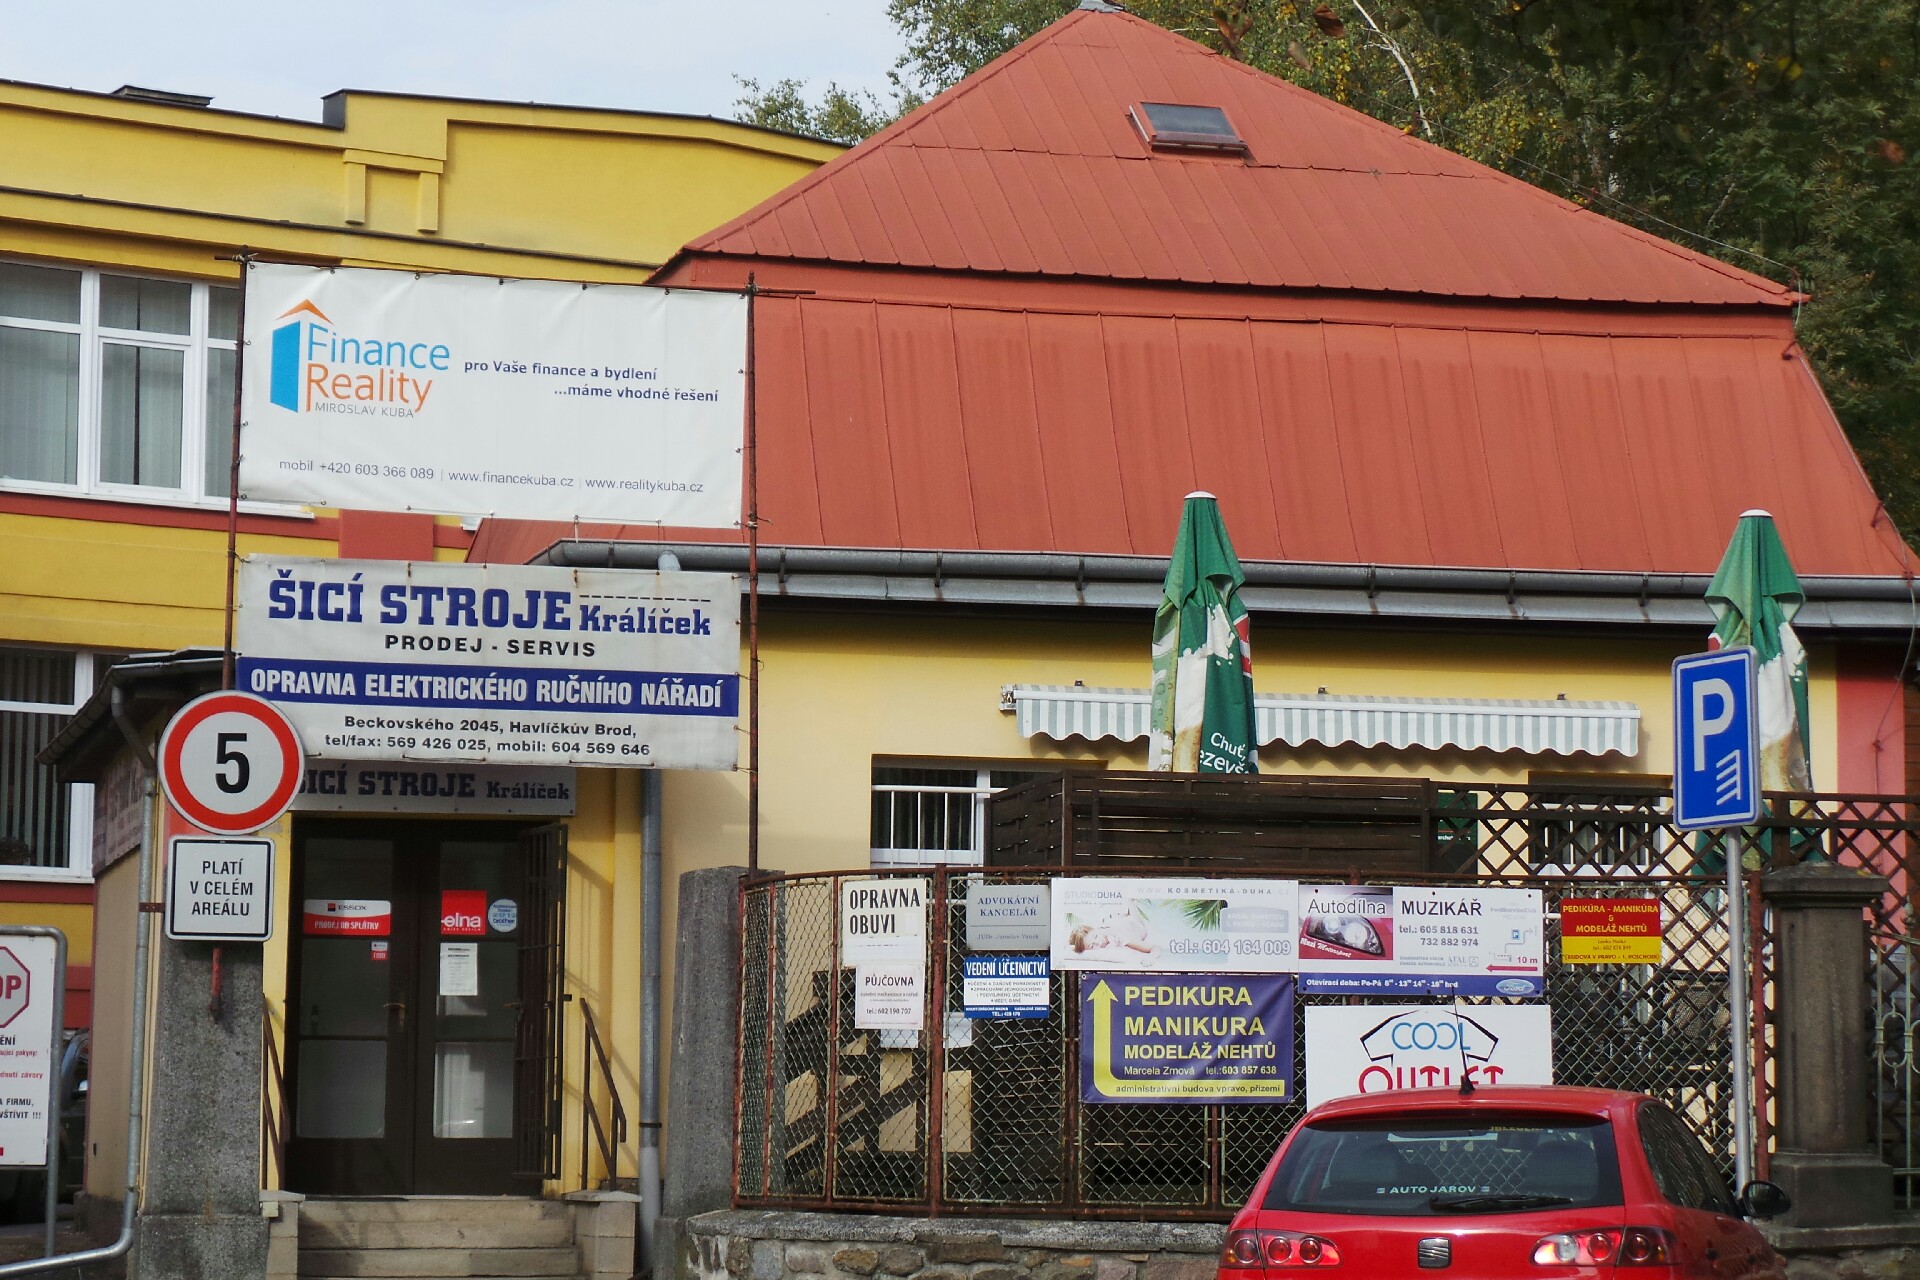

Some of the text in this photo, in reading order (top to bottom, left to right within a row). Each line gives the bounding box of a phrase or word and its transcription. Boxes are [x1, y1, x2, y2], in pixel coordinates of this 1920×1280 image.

[307, 321, 450, 371] Finance
[464, 359, 658, 381] pro Vaše finance a bydlení
[305, 362, 433, 412] Reality
[554, 384, 719, 402] ...máme vhodné řešení
[314, 402, 414, 418] MIROSLAV KUBA
[279, 458, 704, 494] mobil +420 603 366 089 www.financekuba.cz www.realitykuba.cz
[268, 569, 711, 636] ŠICÍ STROJE Králíček
[385, 635, 483, 654] PRODEJ
[507, 639, 597, 658] SERVIS
[251, 668, 722, 708] OPRAVNA ELEKTRICKÉHO RUČNÍHO NÁŘADÍ
[344, 715, 638, 738] Beckovského 2045, Havlíčkův Brod,
[1692, 677, 1735, 773] P
[325, 733, 651, 757] tel/fax: 569 426 025, mobil: 604 569 646
[215, 732, 250, 794] 5
[358, 770, 475, 799] STROJE
[486, 781, 570, 801] Králíček
[202, 859, 243, 875] PLATÍ
[190, 878, 253, 896] V CELÉM
[850, 887, 920, 910] OPRAVNA
[977, 894, 1040, 905] ADVOKÁTNÍ
[1308, 898, 1386, 914] Autodílna
[1401, 898, 1483, 916] MUZIKÁŘ
[191, 899, 250, 917] AREÁLU
[980, 906, 1037, 916] KANCELÁŘ
[1563, 904, 1659, 913] PEDIKÚRA MANIKÚRA
[441, 912, 481, 928] elna
[850, 913, 896, 935] OBUVI
[1575, 923, 1648, 932] MODELÁŽ NEHTŮ
[1399, 925, 1479, 935] tel.: 605 818 631
[1202, 940, 1230, 954] 604
[1234, 940, 1261, 955] 164
[1264, 941, 1292, 955] 009
[1420, 938, 1479, 947] 732 882 974
[966, 957, 1047, 976] VEDENÍ ÚČETNICTVÍ
[865, 973, 914, 986] PŮJČOVNA
[1124, 986, 1253, 1006] PEDIKURA
[1124, 1016, 1266, 1036] MANIKURA
[1124, 1041, 1276, 1060] MODELÁŽ NEHTŮ
[1124, 1066, 1161, 1076] Marcela
[1241, 1066, 1258, 1075] 857
[1260, 1066, 1277, 1075] 638
[1182, 1083, 1214, 1094] budova
[1216, 1085, 1248, 1095] vpravo,
[6, 1097, 34, 1107] FIRMU,
[1389, 1185, 1476, 1194] AUTO JAROV
